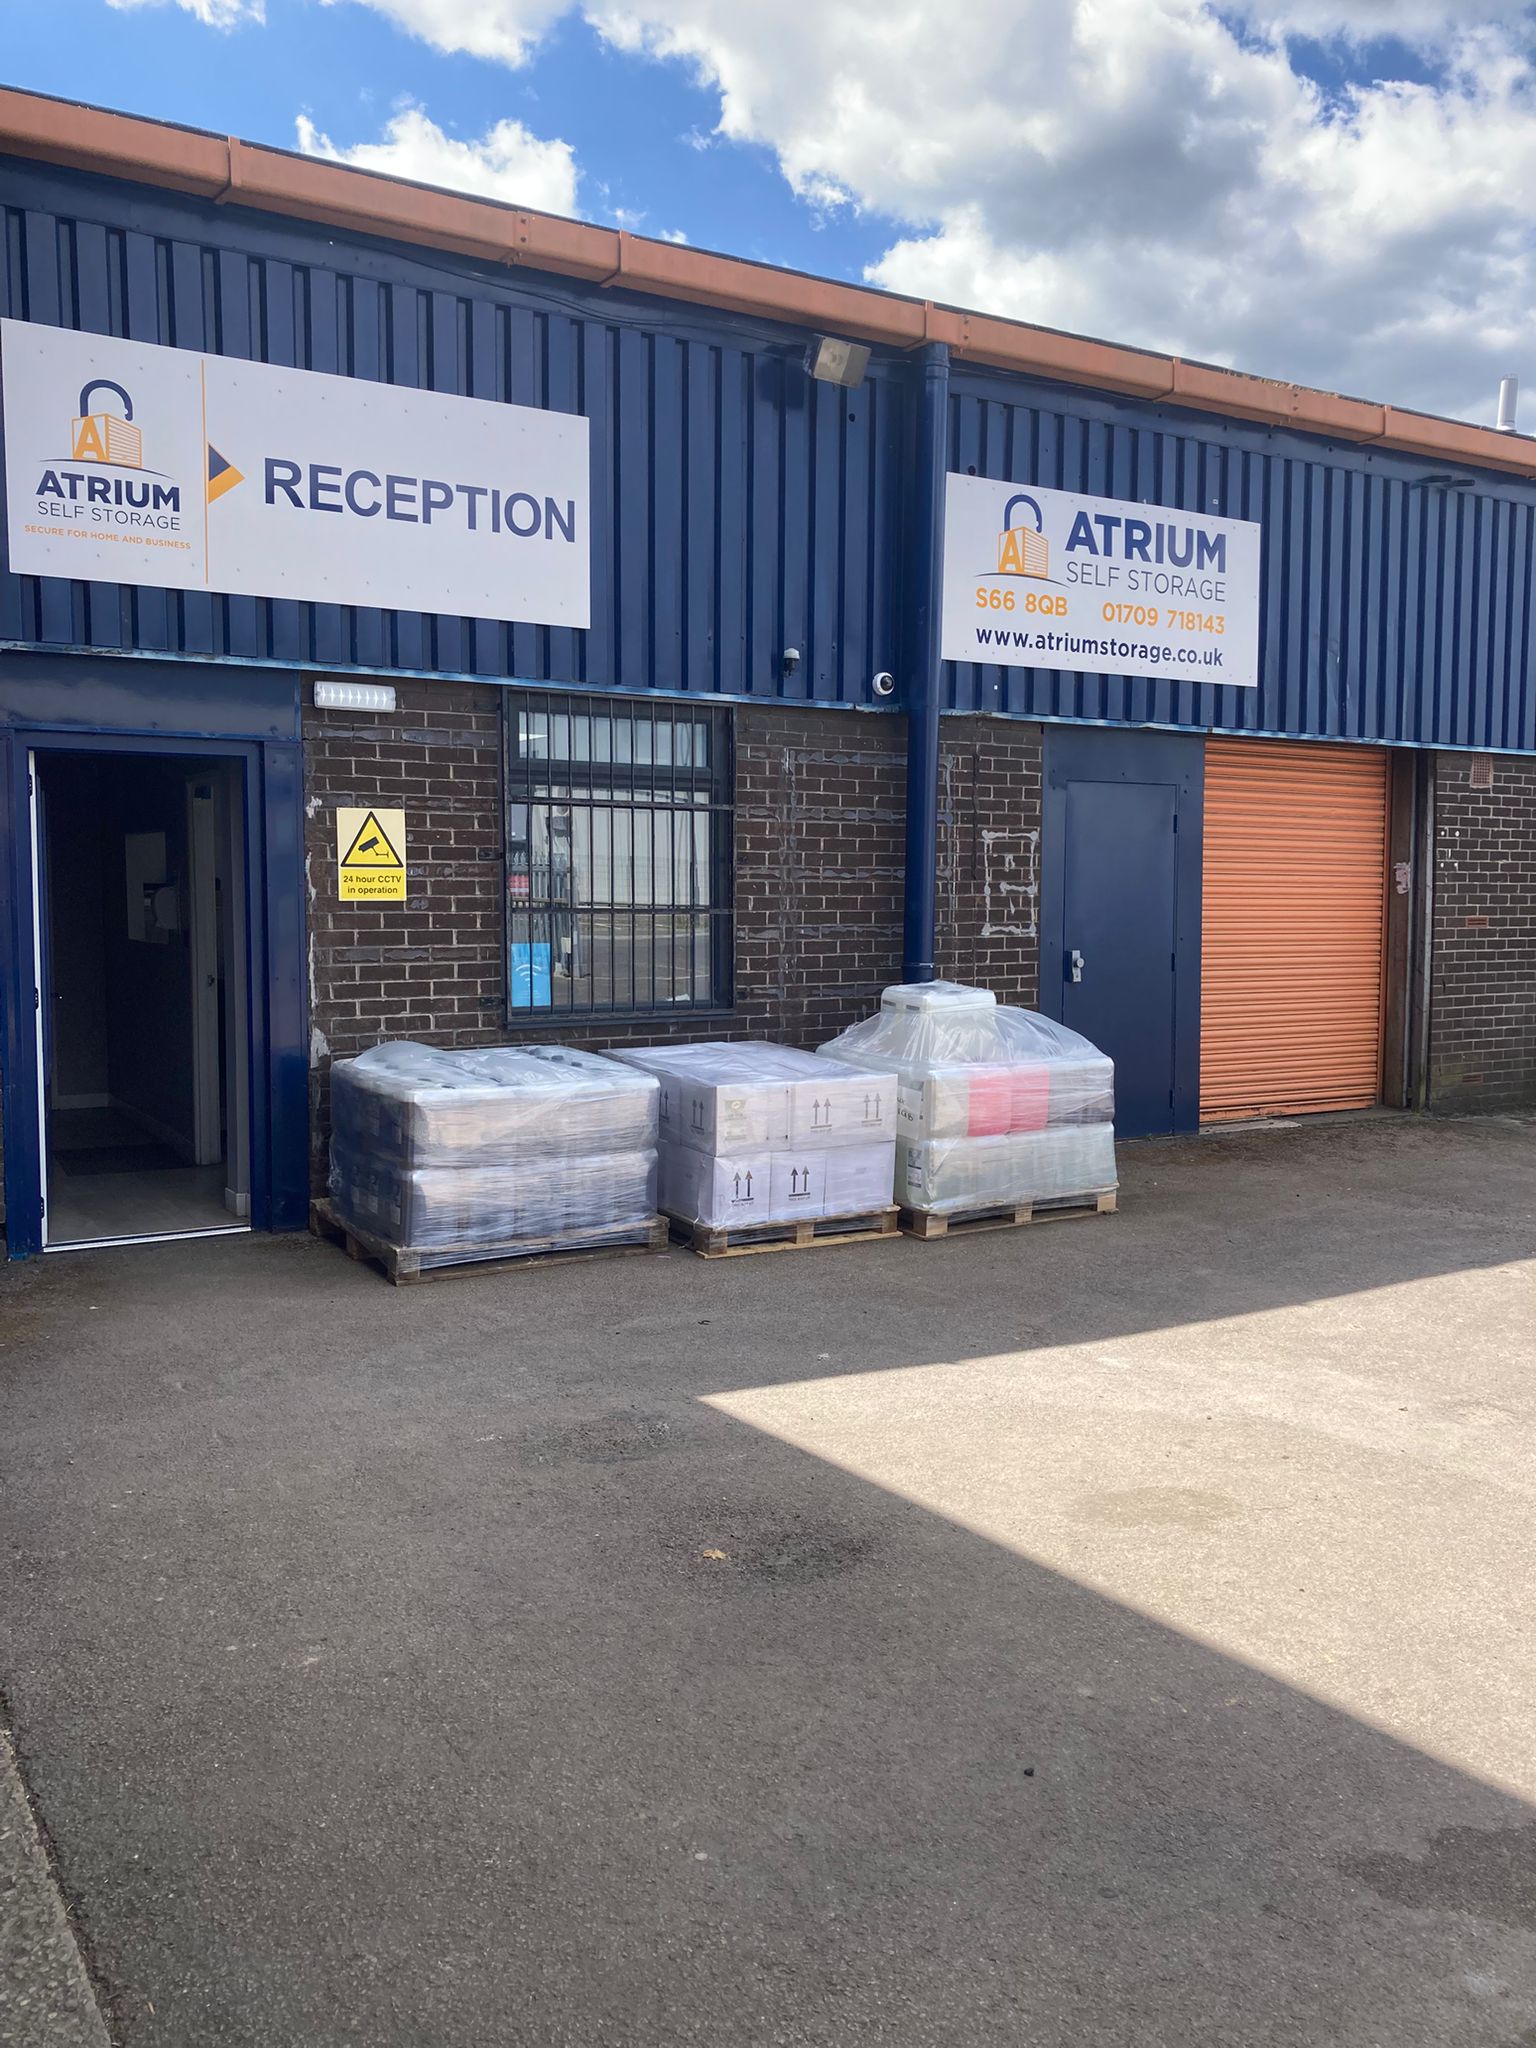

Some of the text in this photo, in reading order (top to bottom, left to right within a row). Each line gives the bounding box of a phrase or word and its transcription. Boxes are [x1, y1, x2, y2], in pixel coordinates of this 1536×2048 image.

[35, 469, 181, 512] ATRIUM
[264, 456, 576, 543] RECEPTION
[37, 501, 181, 531] SELF STORAGE
[24, 524, 192, 550] SECURE FOR HOME AND BUSINESS
[1065, 510, 1227, 574] ATRIUM
[1066, 561, 1227, 602] SELF STORAGE
[975, 587, 1226, 635] S66 8QB 01709 718143
[976, 627, 1225, 667] www.atriumstorage.co.uk
[343, 875, 402, 883] 24 hour CCTV
[347, 886, 398, 895] in operation
